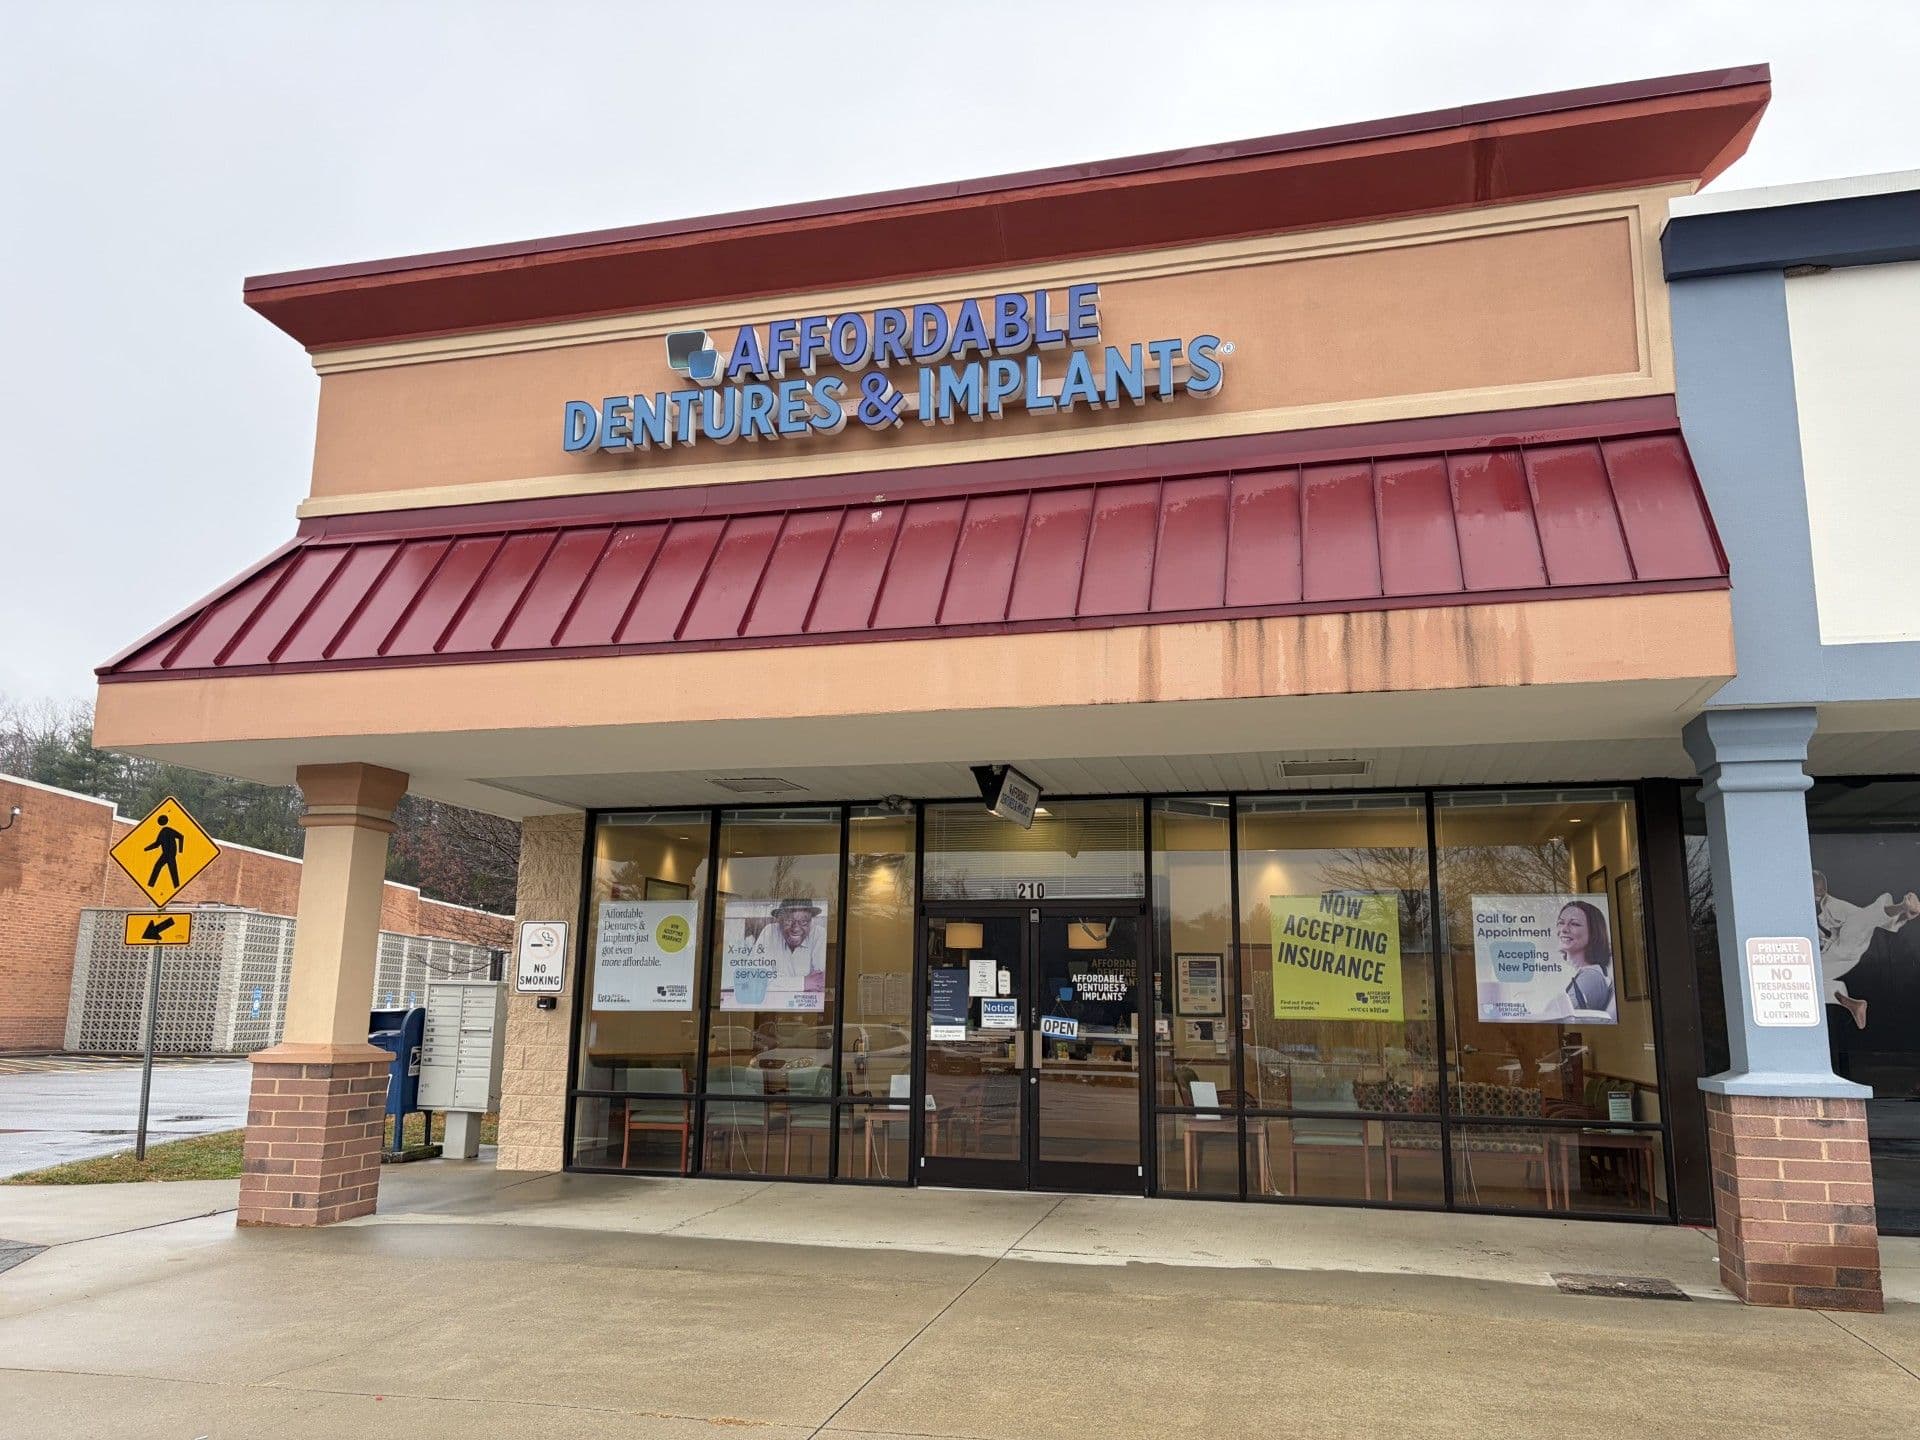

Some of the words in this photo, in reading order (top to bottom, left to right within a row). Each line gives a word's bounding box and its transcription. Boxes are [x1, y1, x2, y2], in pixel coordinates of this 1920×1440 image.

[727, 282, 1100, 380] AFFORDABLE
[563, 376, 846, 453] DENTURES
[857, 370, 904, 427] &
[1018, 882, 1045, 899] 210
[1320, 894, 1363, 920] NOW
[604, 908, 643, 919] Affordable
[1476, 913, 1499, 924] Call
[1502, 913, 1517, 924] for
[1520, 915, 1536, 924] an
[604, 921, 638, 931] Dentures
[638, 920, 646, 931] &
[603, 932, 635, 945] Implants
[635, 933, 649, 945] just
[1283, 914, 1388, 955] ACCEPTING
[1477, 927, 1551, 939] Appointment
[602, 946, 614, 957] got
[615, 947, 633, 955] even
[727, 944, 753, 956] X-ray
[756, 943, 765, 954] &
[1757, 943, 1800, 953] PRIVATE
[1497, 949, 1549, 961] Accepting
[1752, 953, 1809, 964] PROPERTY
[602, 958, 622, 967] more
[730, 957, 777, 967] extraction
[1277, 941, 1386, 984] INSURANCE
[1498, 962, 1520, 972] New
[1522, 962, 1562, 972] Patients
[533, 963, 547, 974] NO
[735, 969, 778, 979] services
[1071, 974, 1125, 983] AFFORDABLE
[1771, 968, 1792, 981] NO
[519, 975, 560, 986] SMOKING
[1076, 983, 1119, 992] DENTURES
[1120, 983, 1128, 992] &
[1755, 982, 1811, 991] TRESPASSING
[1760, 992, 1809, 1001] SOLICITING
[984, 1002, 1015, 1012] Notice
[1779, 1001, 1792, 1009] OR
[1763, 1010, 1810, 1019] LOITERING
[1043, 1019, 1075, 1036] OPEN
